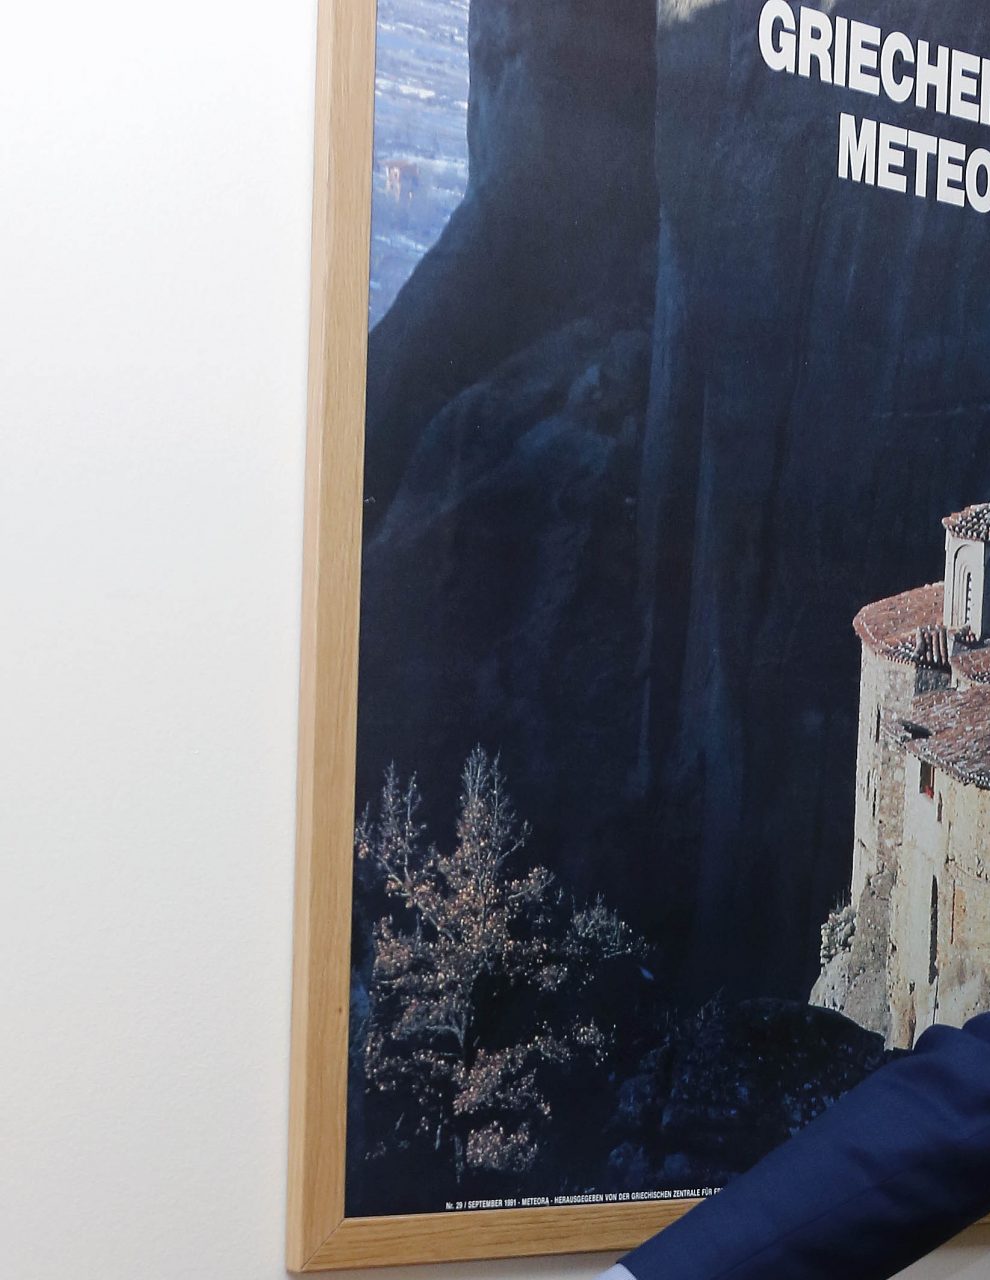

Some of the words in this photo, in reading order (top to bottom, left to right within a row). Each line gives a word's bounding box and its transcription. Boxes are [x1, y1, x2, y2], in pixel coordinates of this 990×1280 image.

[468, 1199, 502, 1209] SEPTEMBER
[522, 1197, 549, 1206] METEORA
[554, 1194, 603, 1204] HERAUSGEGEBEN
[605, 1193, 617, 1201] VON
[631, 1190, 672, 1199] GRIECHISCHEN
[673, 1189, 700, 1198] ZENTRALE
[702, 1187, 712, 1196] FÜR
